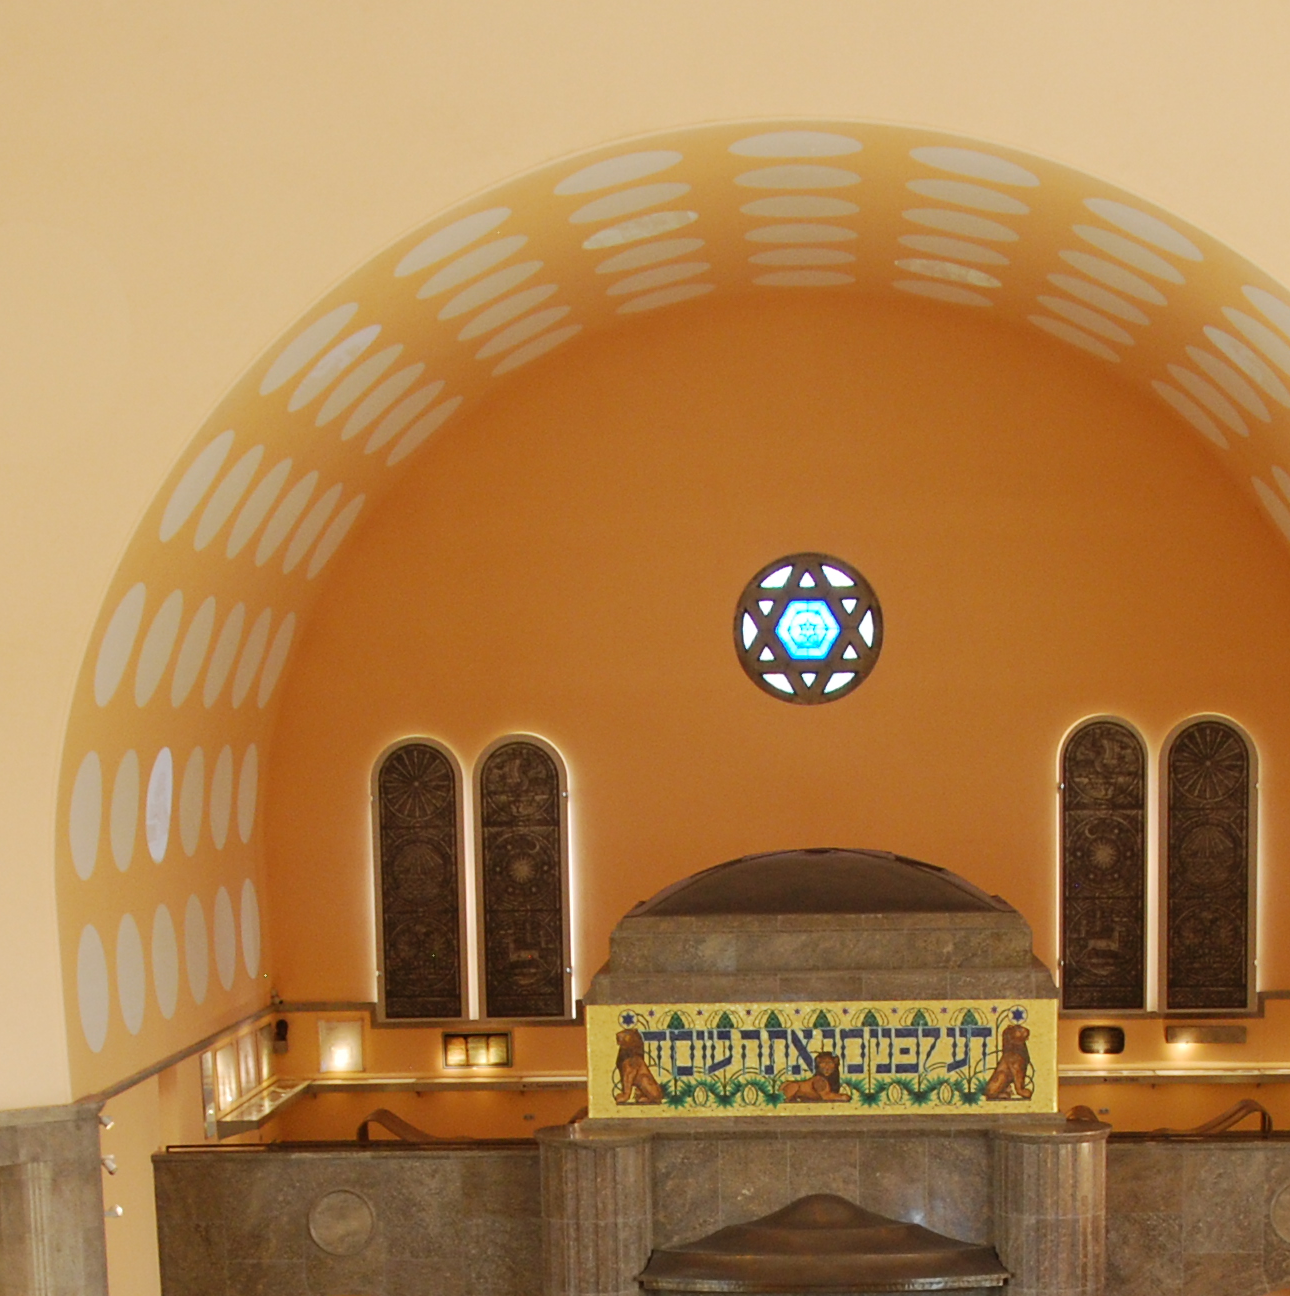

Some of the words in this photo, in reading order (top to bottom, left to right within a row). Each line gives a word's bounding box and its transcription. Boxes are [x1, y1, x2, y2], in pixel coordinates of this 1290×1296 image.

[640, 1028, 733, 1078] עומד
[739, 1028, 816, 1076] אתה
[821, 1027, 866, 1075] מי
[869, 1021, 942, 1075] לפני
[946, 1026, 993, 1075] דע
